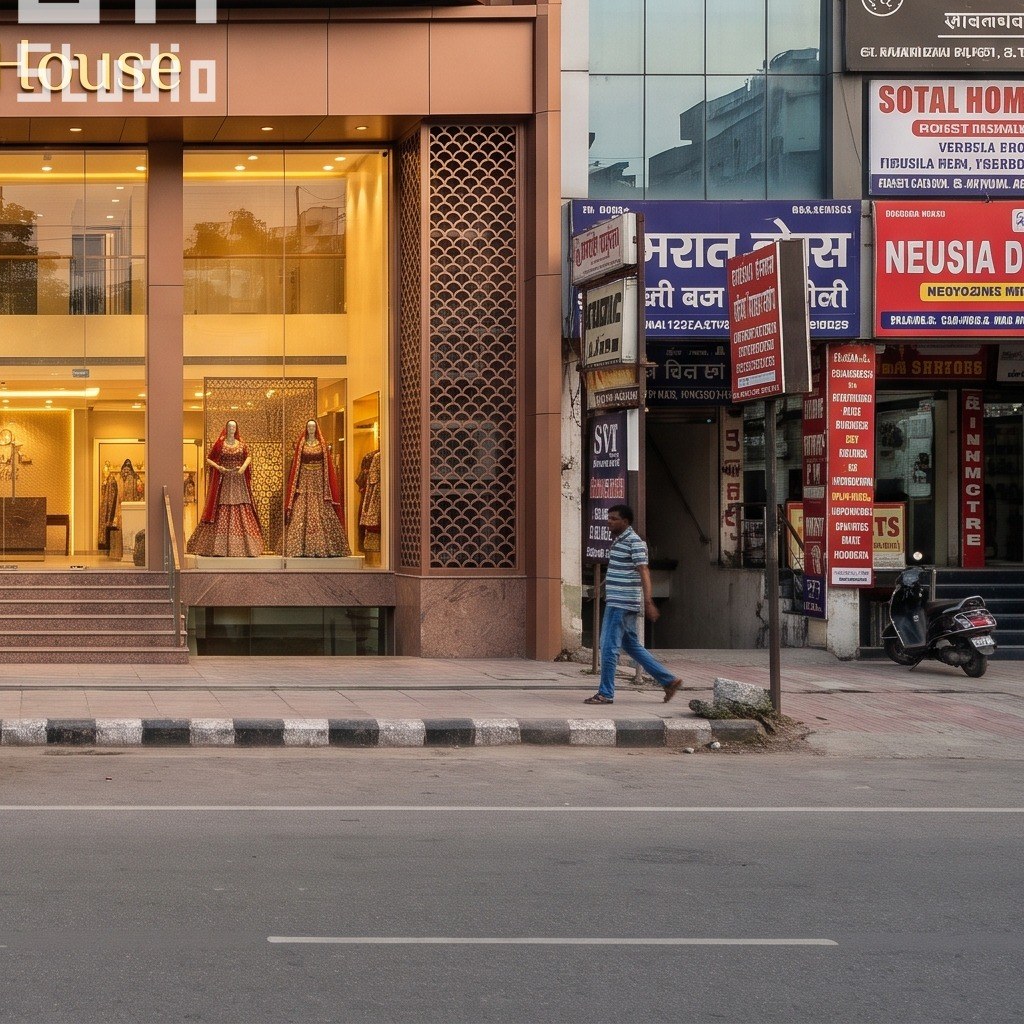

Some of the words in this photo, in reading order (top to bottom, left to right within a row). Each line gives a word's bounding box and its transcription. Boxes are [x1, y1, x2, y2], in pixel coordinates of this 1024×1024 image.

[879, 85, 959, 114] SOTAL
[886, 240, 995, 274] NEUSIA
[1005, 240, 1023, 274] D
